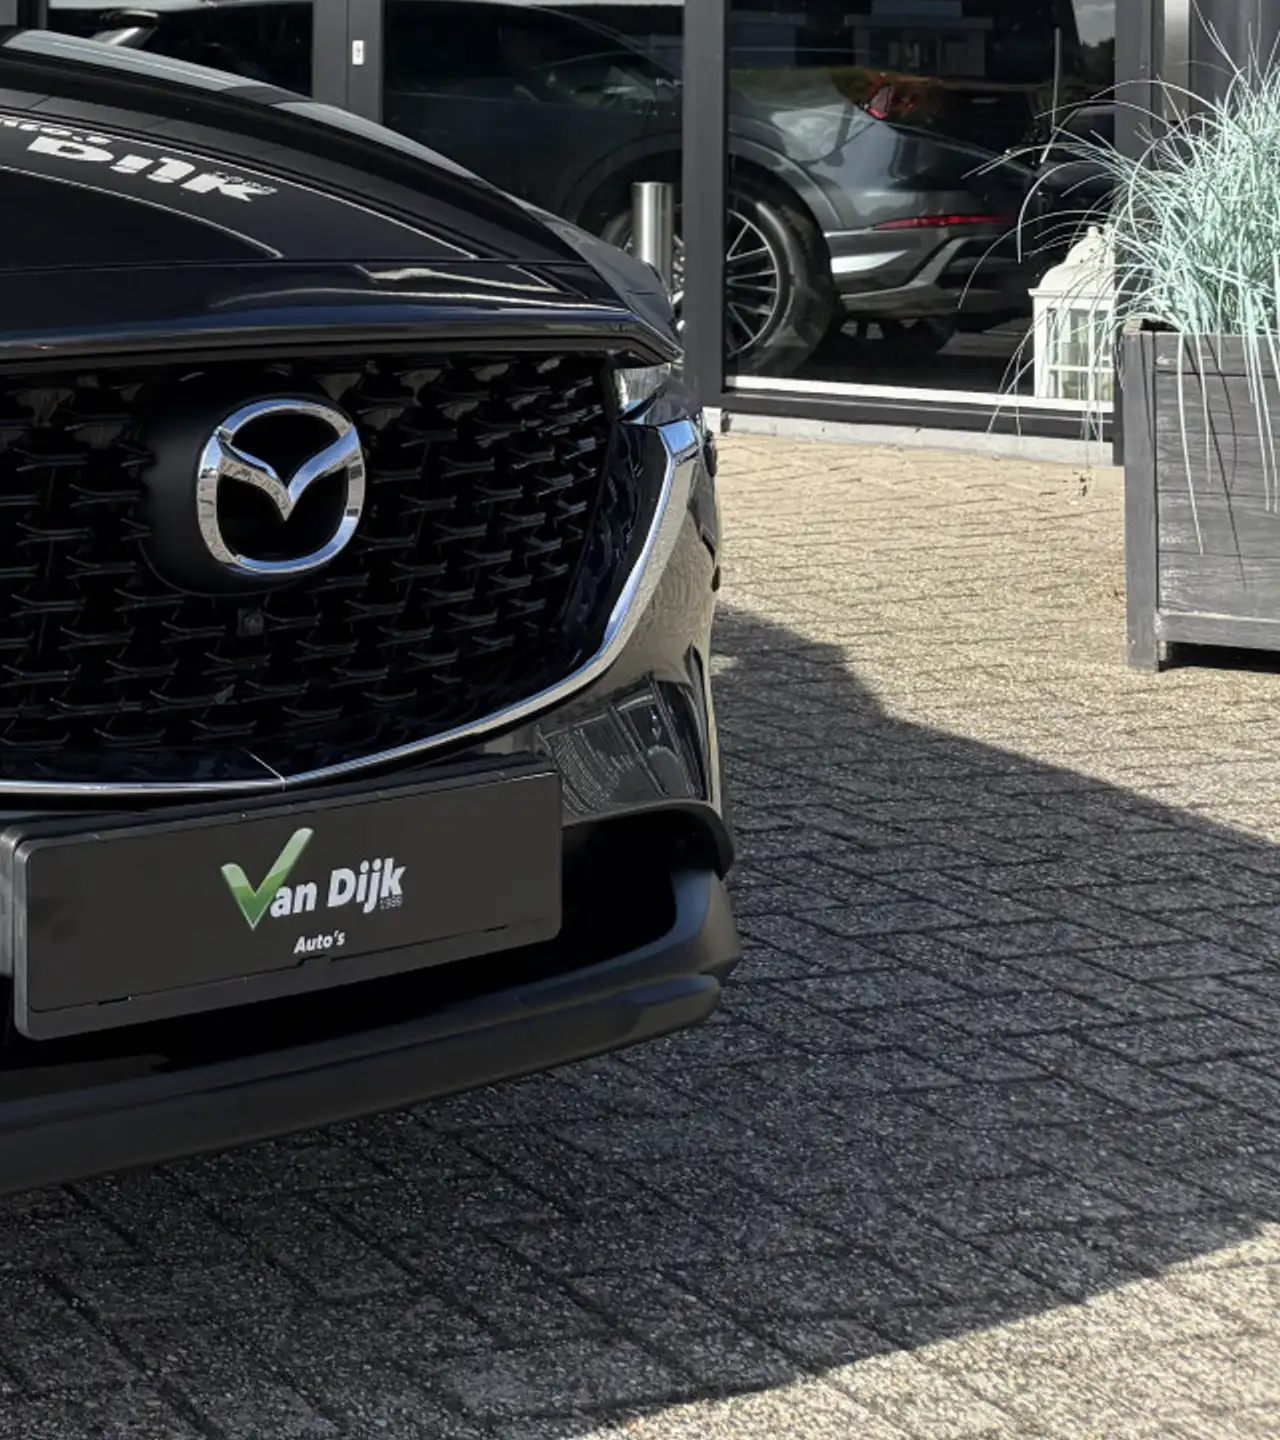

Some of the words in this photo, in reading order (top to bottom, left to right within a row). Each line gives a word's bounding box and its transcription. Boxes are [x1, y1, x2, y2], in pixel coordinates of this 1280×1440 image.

[220, 827, 317, 931] Van
[327, 857, 406, 914] Dijk
[293, 929, 347, 954] Auto's
